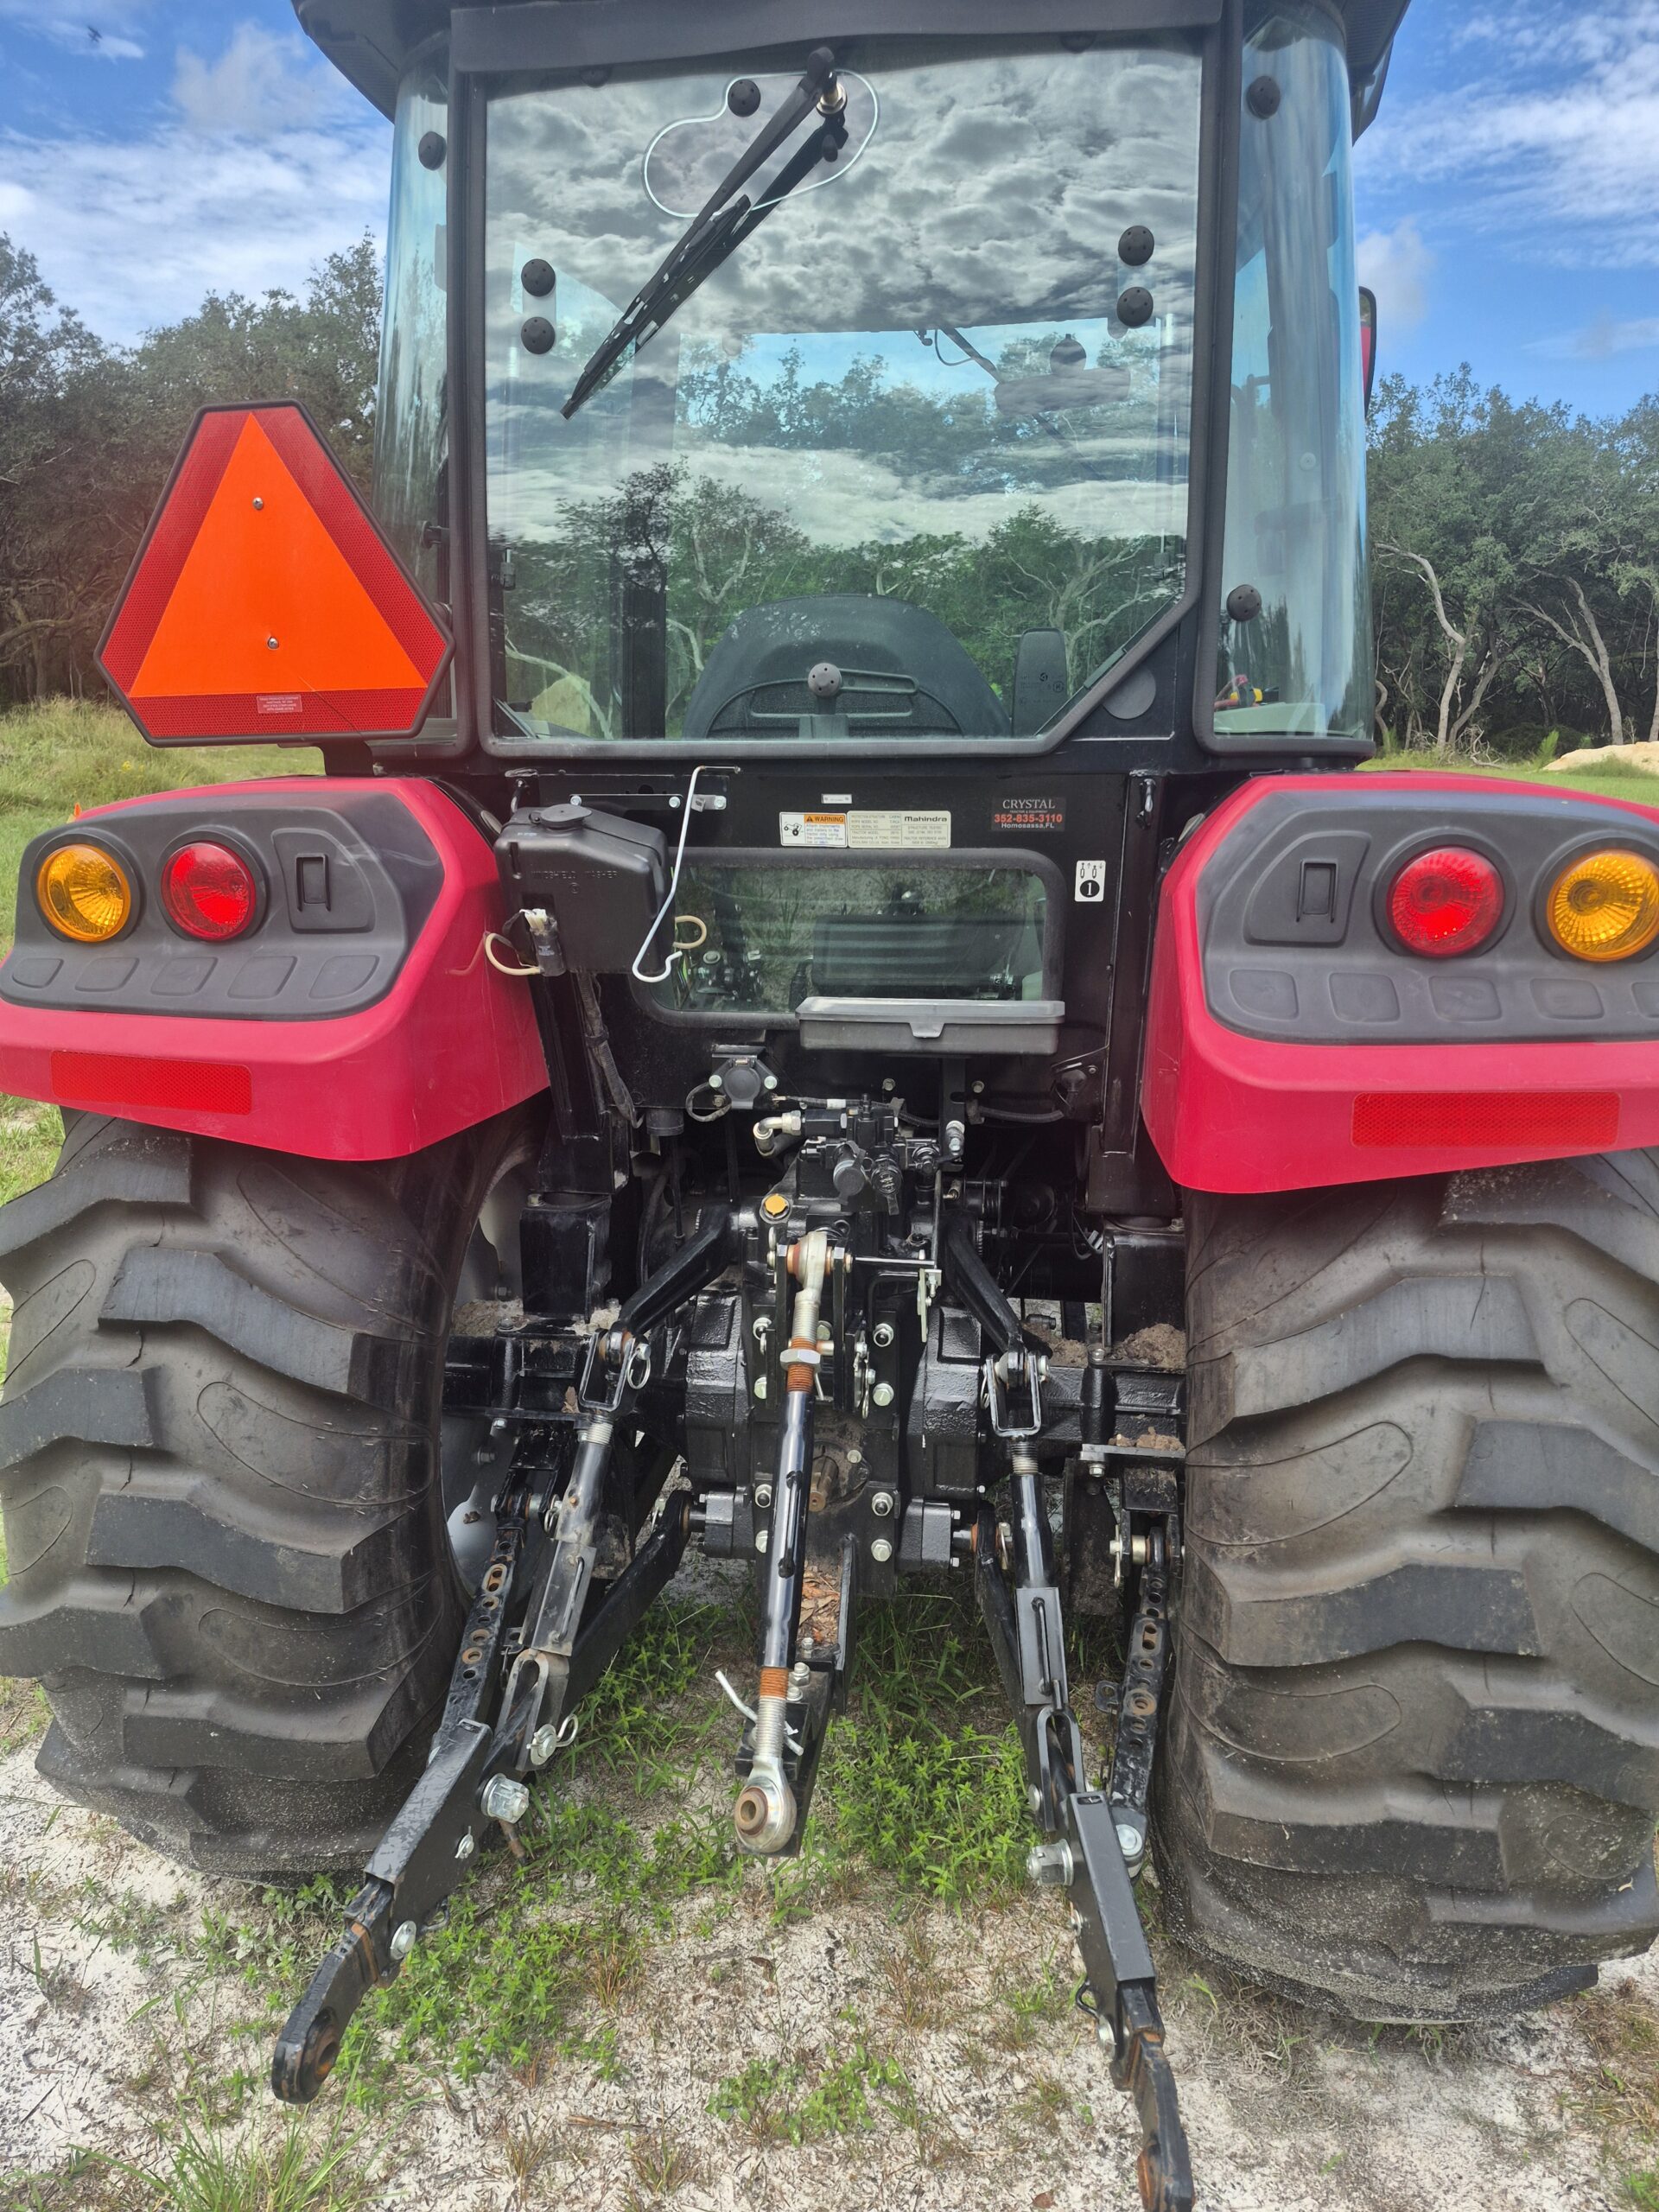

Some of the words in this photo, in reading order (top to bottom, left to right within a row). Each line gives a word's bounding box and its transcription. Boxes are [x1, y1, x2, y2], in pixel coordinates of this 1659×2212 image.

[1002, 798, 1056, 810] CRYSTAL
[994, 813, 1063, 823] 352-835-3110
[1086, 881, 1093, 896] 1
